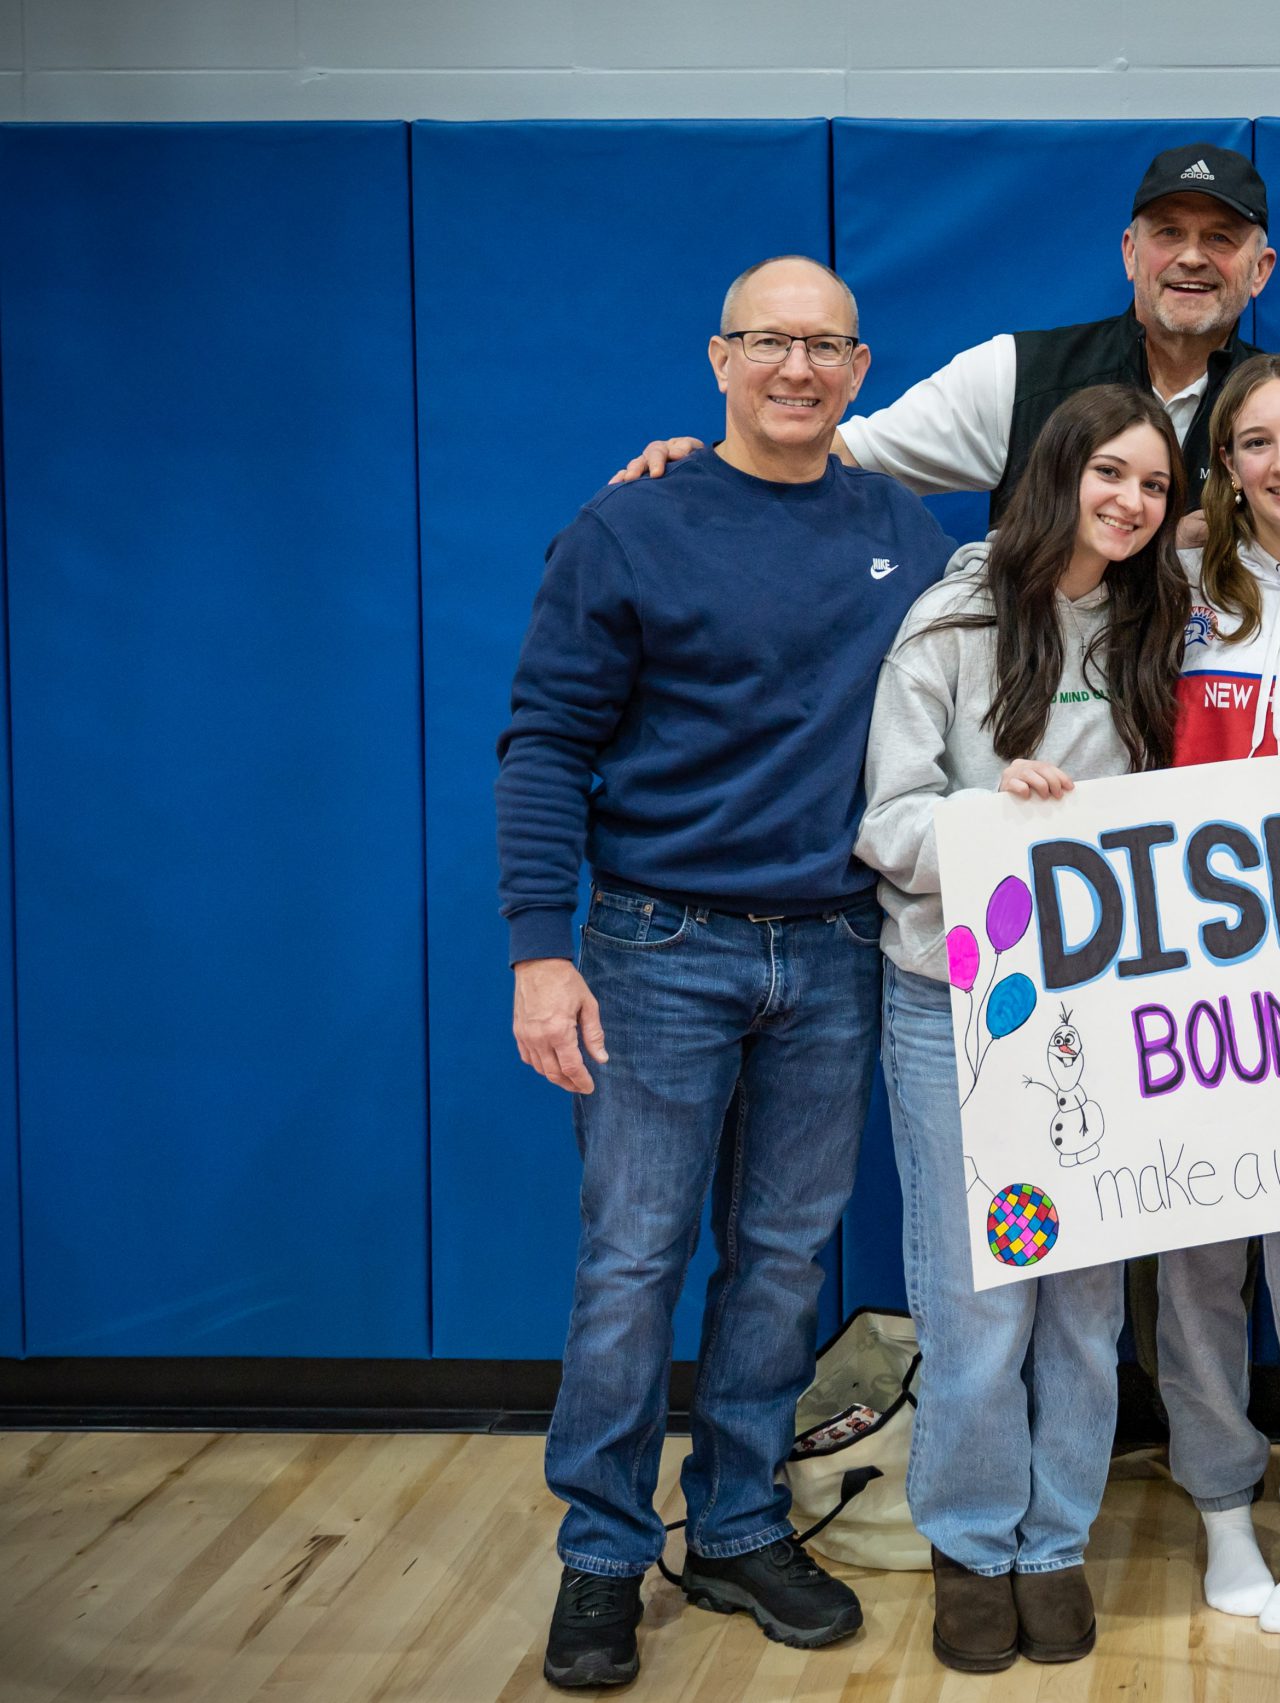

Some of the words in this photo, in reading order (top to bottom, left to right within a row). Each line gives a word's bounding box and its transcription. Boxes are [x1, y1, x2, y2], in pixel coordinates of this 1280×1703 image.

[1180, 171, 1215, 180] adidas
[872, 557, 891, 570] NIKE
[1060, 690, 1090, 704] MIND
[1204, 681, 1254, 710] NEW
[1093, 1138, 1224, 1221] make
[1234, 1152, 1268, 1200] a
